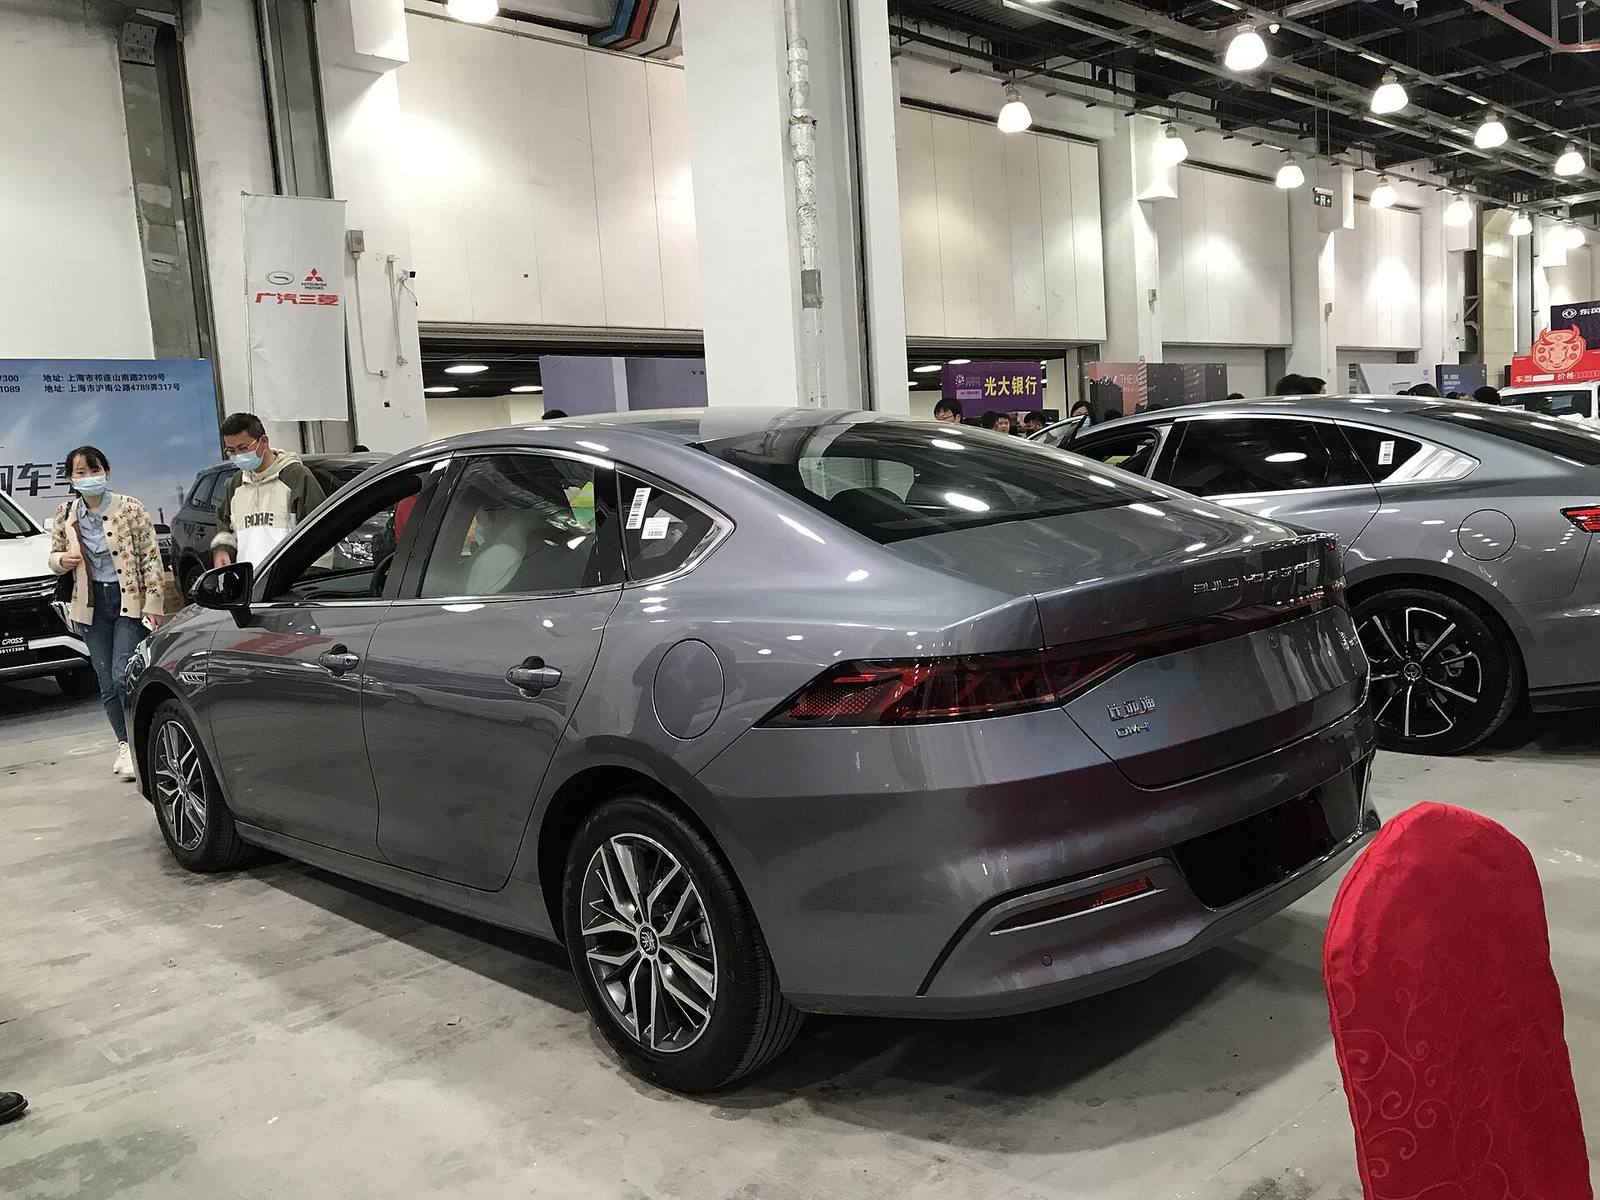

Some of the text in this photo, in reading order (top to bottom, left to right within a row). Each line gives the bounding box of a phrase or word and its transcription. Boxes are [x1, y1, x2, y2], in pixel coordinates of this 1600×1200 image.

[255, 292, 338, 306] 广汽三菱
[0, 374, 19, 382] 300
[984, 375, 1037, 396] 光大银行
[1193, 577, 1240, 593] BUILD
